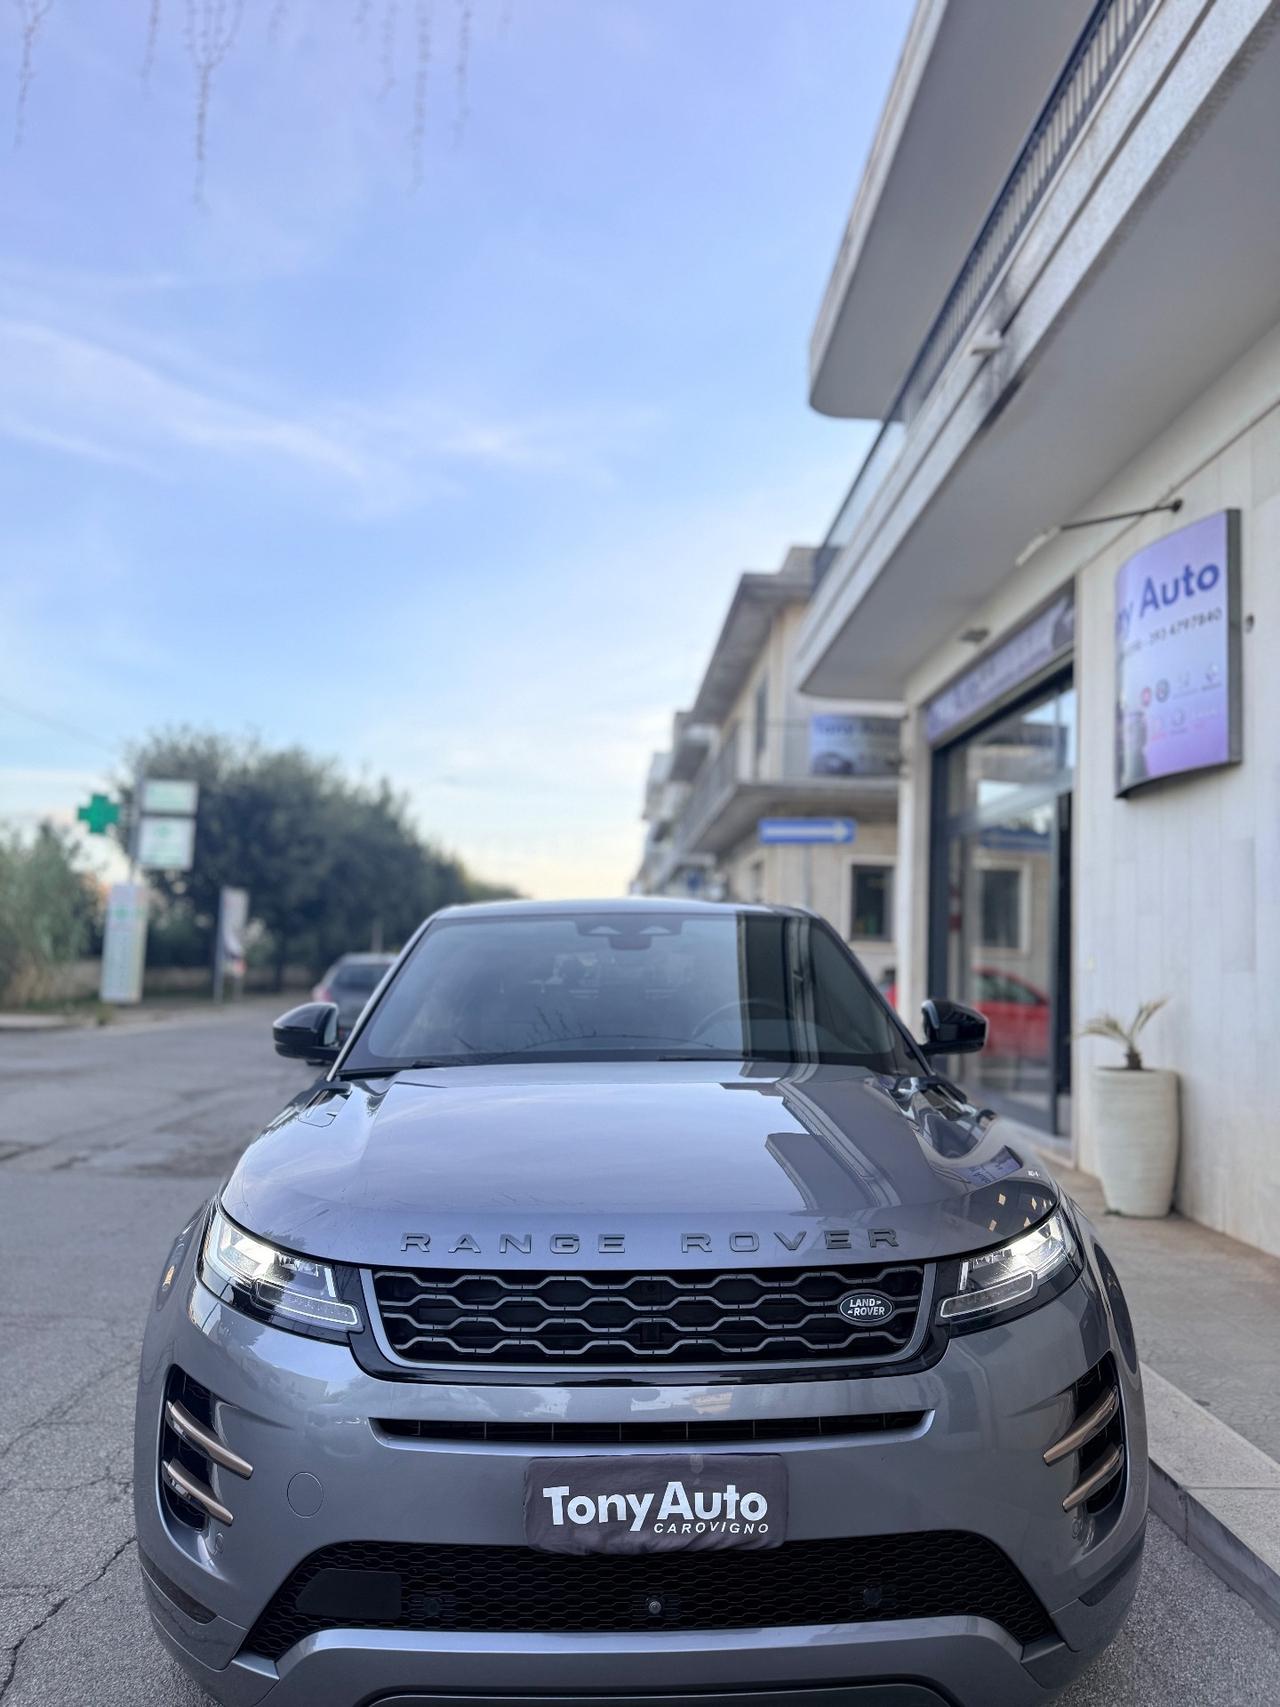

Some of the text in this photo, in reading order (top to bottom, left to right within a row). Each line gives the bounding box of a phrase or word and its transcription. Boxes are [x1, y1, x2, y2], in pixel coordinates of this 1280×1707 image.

[1139, 563, 1220, 619] Auto
[400, 1228, 900, 1255] RANGE ROVER
[850, 1298, 876, 1307] LAND
[853, 1306, 885, 1316] ROVER
[653, 1521, 769, 1535] CAROVIGNO
